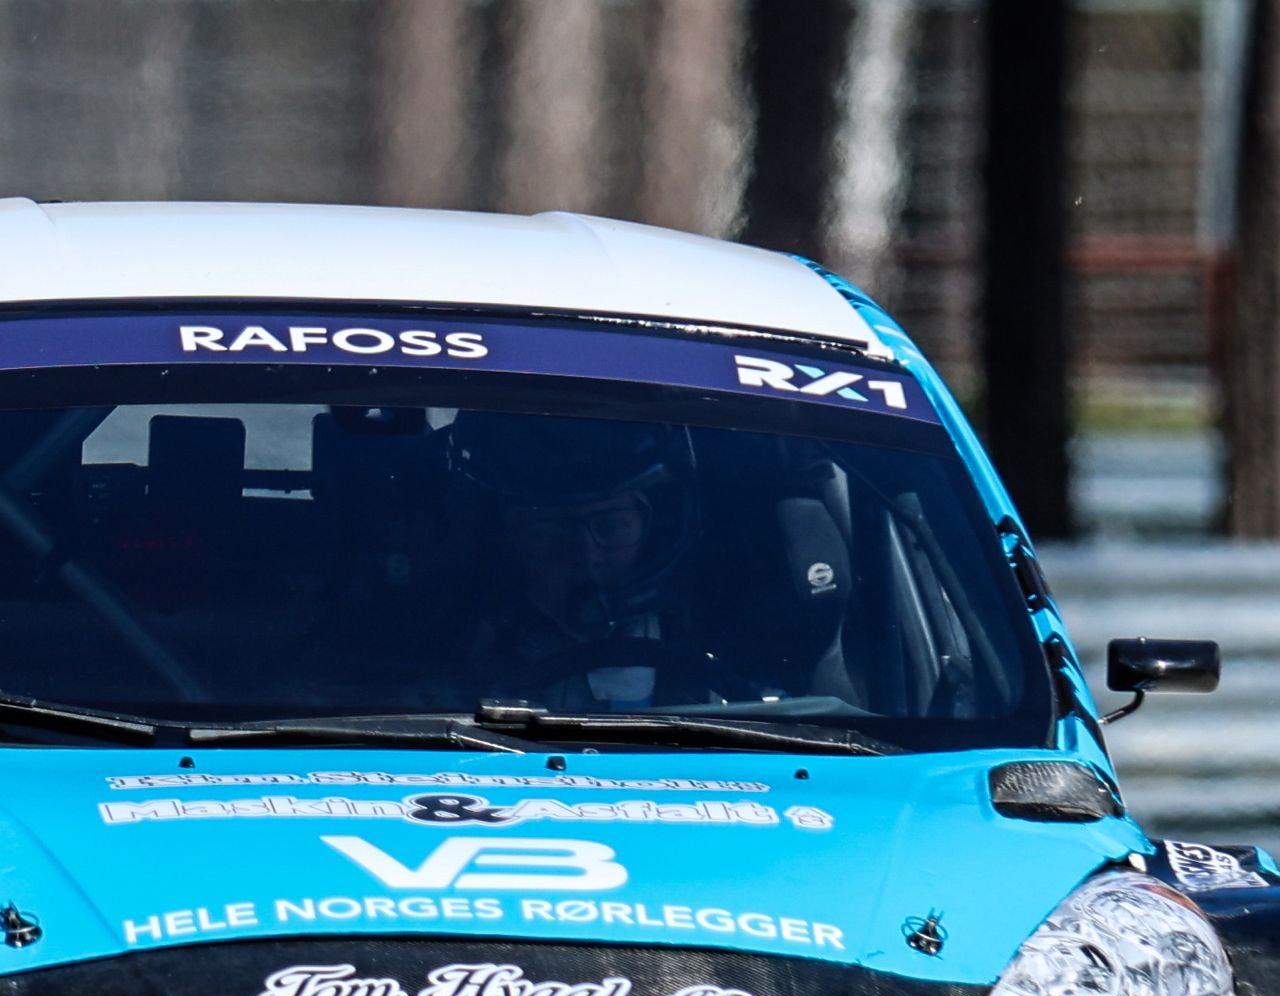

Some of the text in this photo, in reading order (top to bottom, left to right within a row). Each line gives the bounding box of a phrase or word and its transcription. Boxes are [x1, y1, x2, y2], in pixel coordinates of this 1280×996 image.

[179, 326, 489, 358] RAFOSS
[734, 354, 908, 410] RX1
[101, 795, 406, 824] Maskin
[502, 799, 780, 825] Asfalt
[320, 835, 628, 891] VB
[124, 896, 846, 949] HELE NORGES RØRLEGGER
